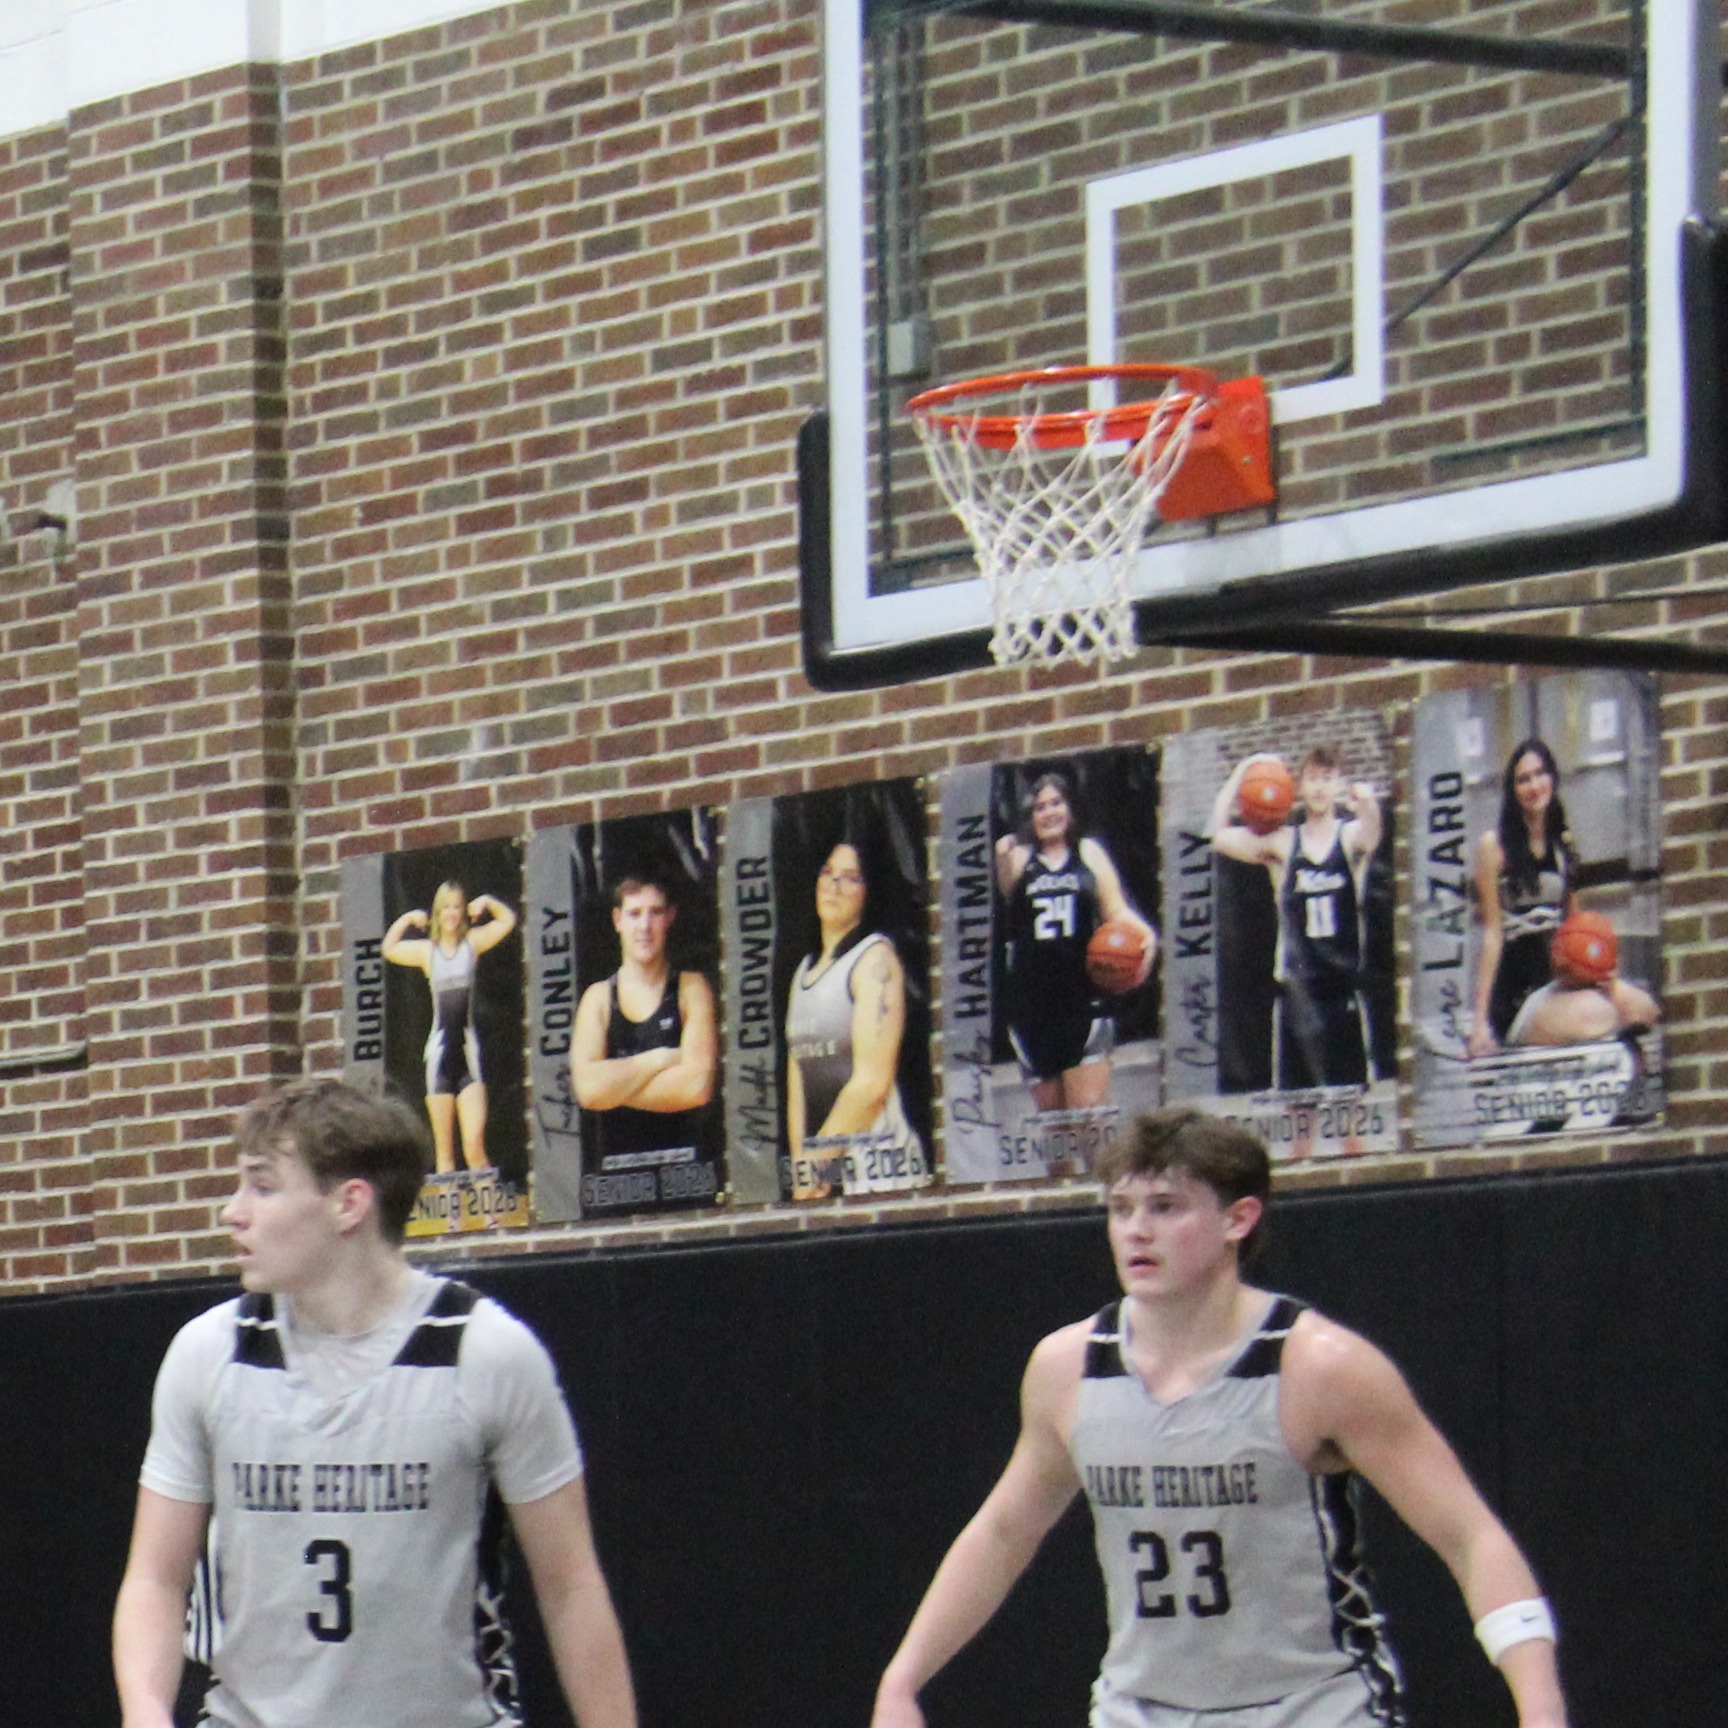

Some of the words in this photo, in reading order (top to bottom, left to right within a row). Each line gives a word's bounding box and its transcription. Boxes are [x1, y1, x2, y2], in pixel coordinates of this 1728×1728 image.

[954, 813, 989, 1020] HARTMAN
[1031, 894, 1075, 940] 24
[1174, 831, 1214, 966] KELLY
[1422, 771, 1464, 971] LAZARO
[354, 936, 383, 1062] BURCH
[540, 905, 572, 1056] CONLEY
[736, 854, 771, 1050] CROWDER
[312, 1461, 430, 1513] HERITAGE
[1151, 1462, 1259, 1508] HERITAGE
[304, 1539, 352, 1643] 3
[1128, 1531, 1232, 1618] 23
